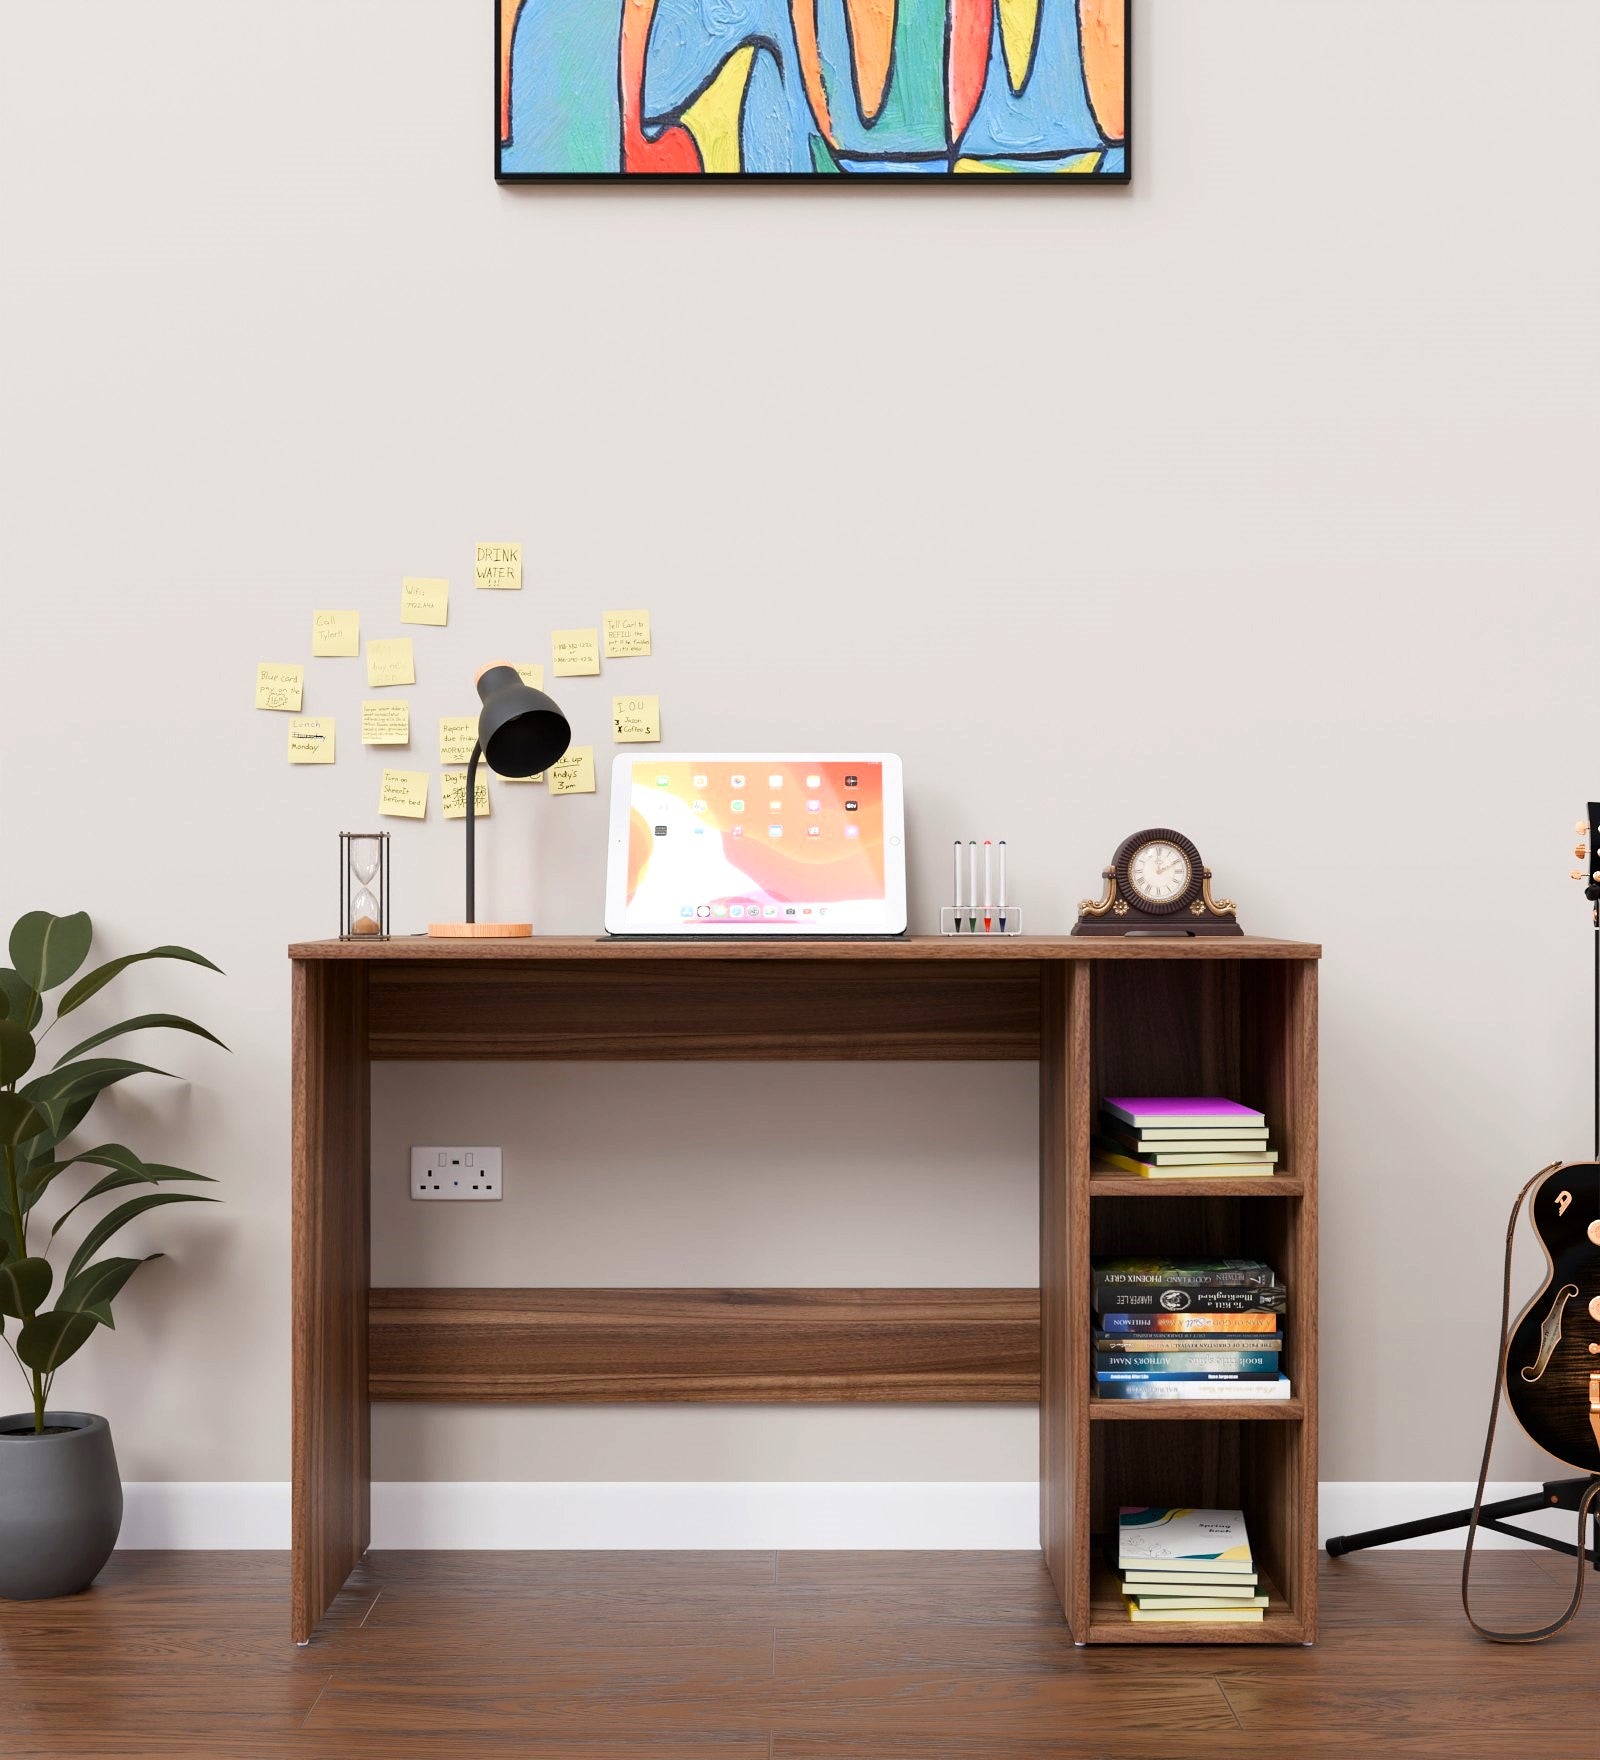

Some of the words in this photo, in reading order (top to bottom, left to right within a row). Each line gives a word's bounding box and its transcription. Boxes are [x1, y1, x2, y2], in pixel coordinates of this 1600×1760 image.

[477, 548, 518, 562] DRINK
[476, 567, 514, 579] WATER
[316, 616, 336, 626] Call
[260, 670, 278, 680] Blue
[280, 675, 298, 683] card
[293, 720, 320, 728] Lunch
[444, 724, 470, 734] Report
[292, 743, 319, 754] Monday
[444, 774, 458, 784] Dog
[1104, 1274, 1126, 1282] GREY
[1128, 1274, 1162, 1282] PHOENIX
[1116, 1296, 1128, 1304] LEE
[1130, 1296, 1152, 1304] HARPER
[1198, 1291, 1252, 1301] Mockingbird
[1133, 1358, 1171, 1366] AUTHOR'S
